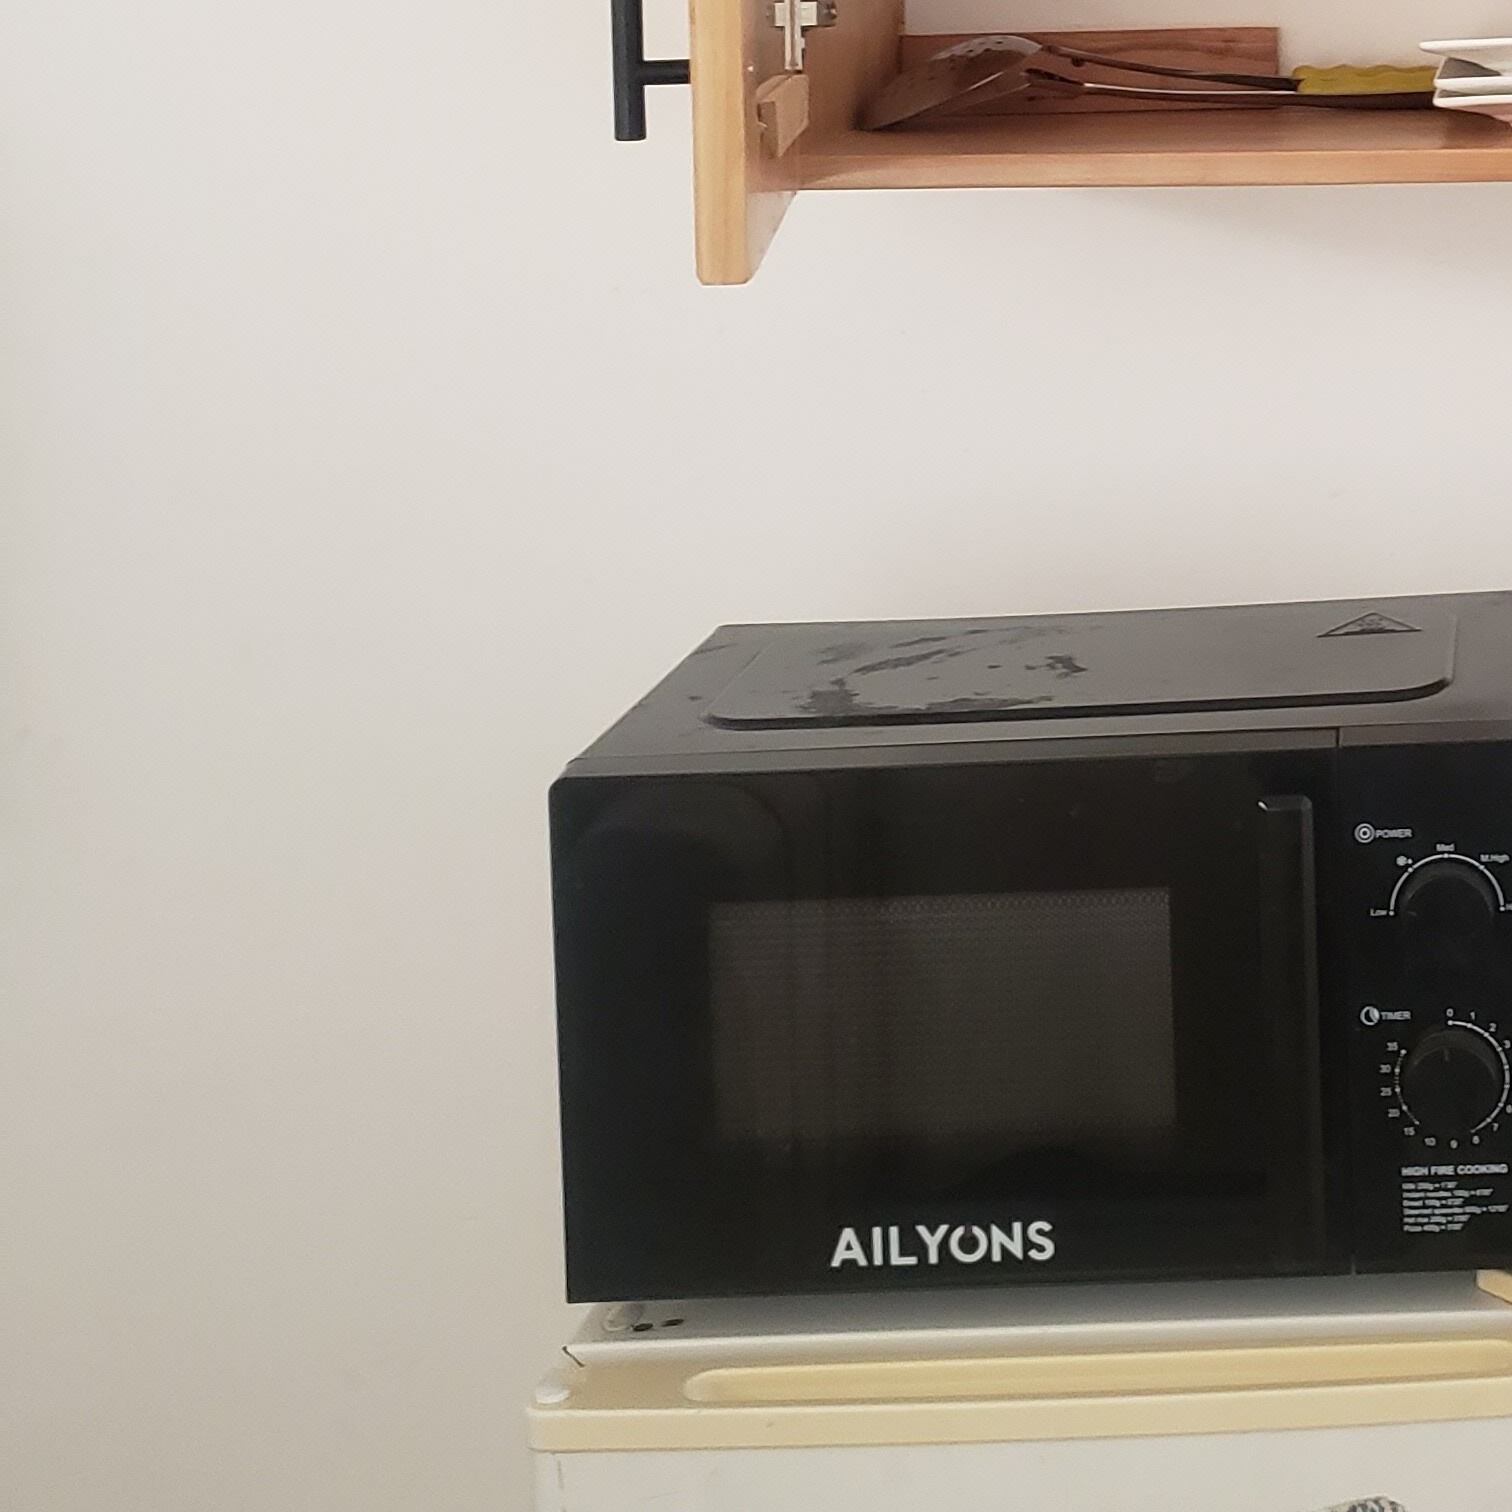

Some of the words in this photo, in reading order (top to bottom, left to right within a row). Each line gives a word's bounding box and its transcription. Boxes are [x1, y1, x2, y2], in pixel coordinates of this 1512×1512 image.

[1375, 829, 1412, 838] POWER
[1381, 1011, 1411, 1020] TIMER
[1470, 1012, 1475, 1020] 1
[1489, 1023, 1496, 1032] 2
[1430, 1165, 1455, 1175] FIRE
[1457, 1164, 1508, 1174] COOKING
[831, 1221, 1055, 1267] AILYONS
